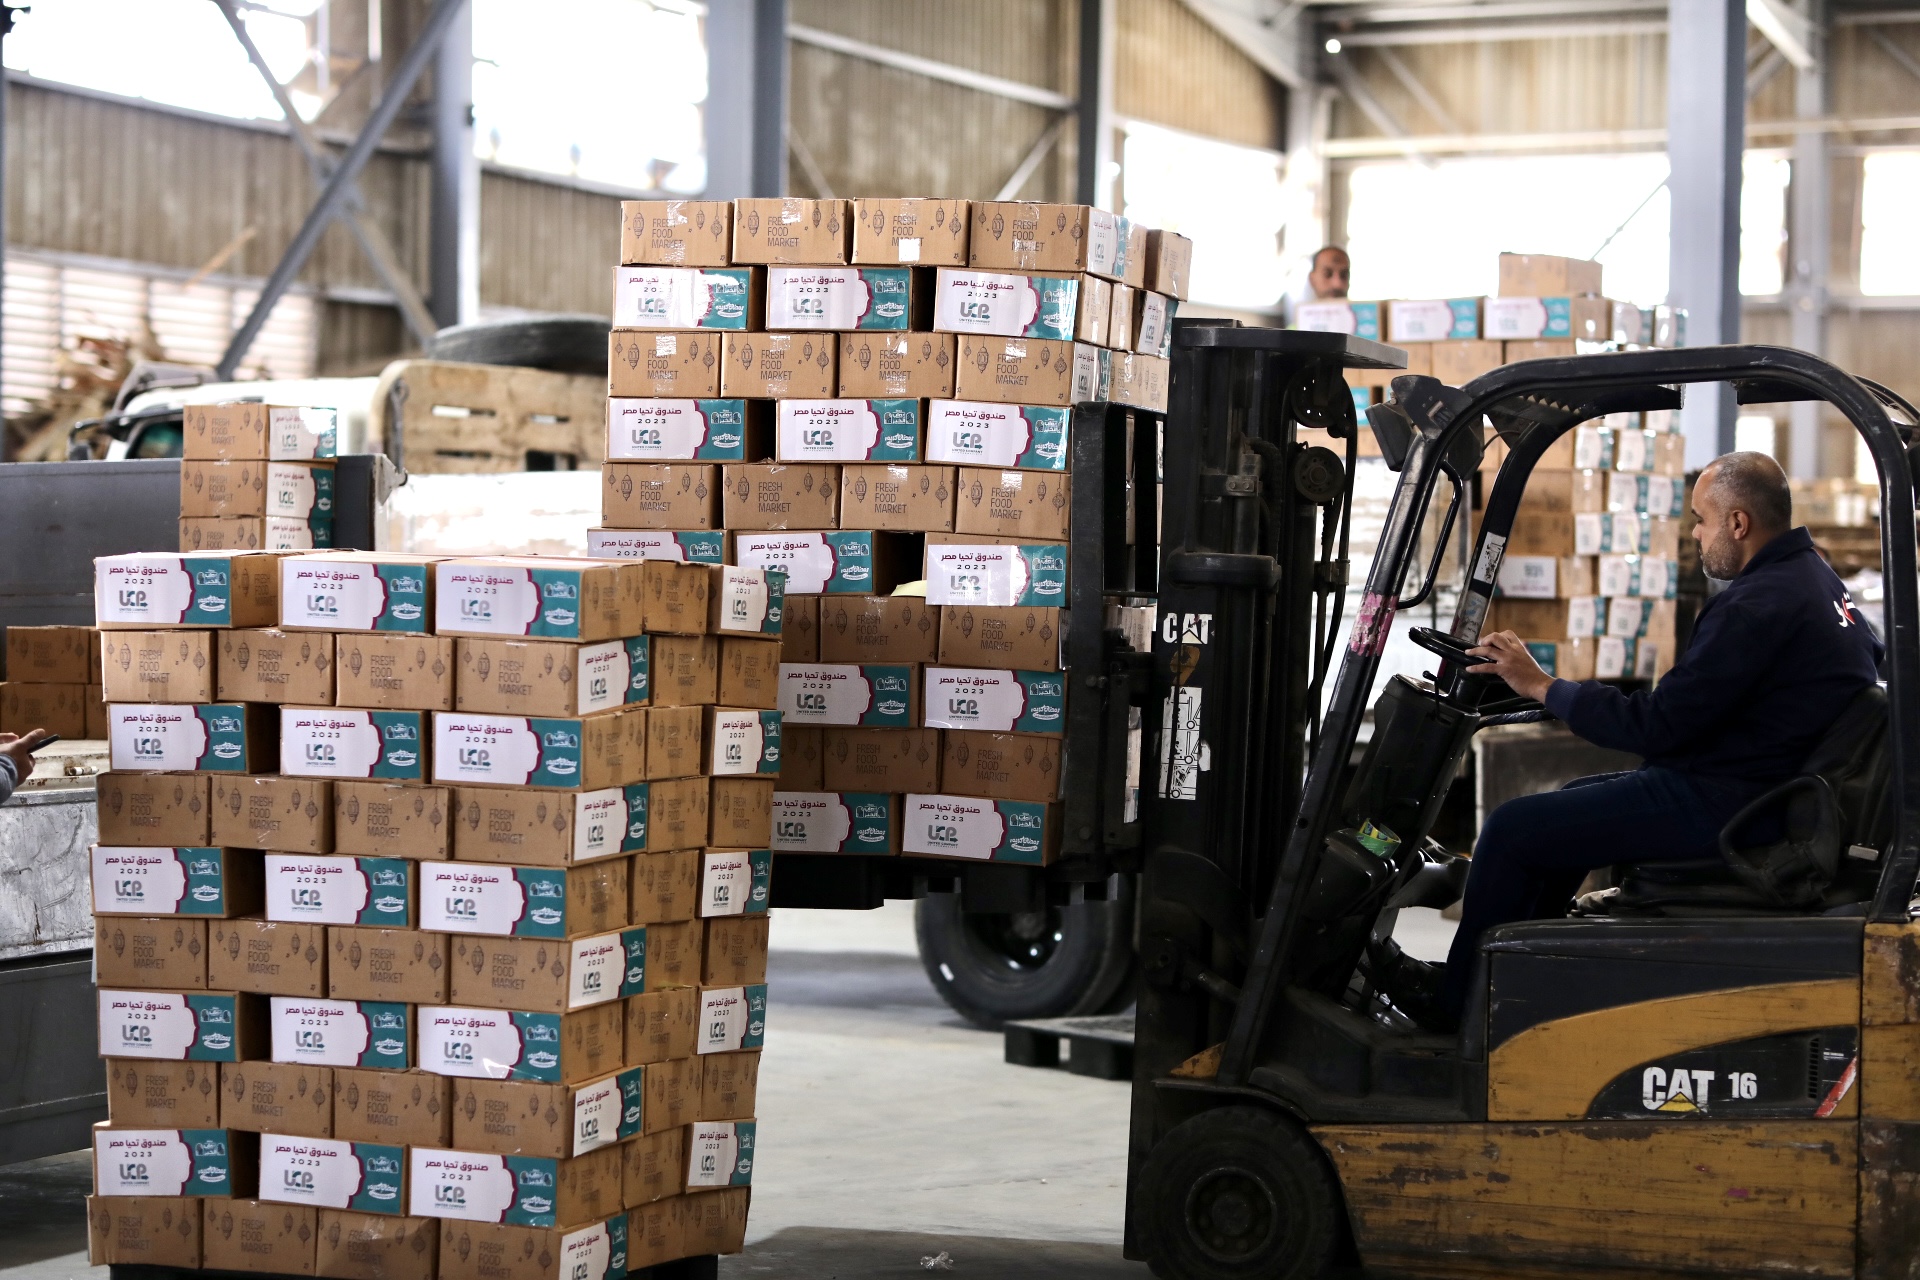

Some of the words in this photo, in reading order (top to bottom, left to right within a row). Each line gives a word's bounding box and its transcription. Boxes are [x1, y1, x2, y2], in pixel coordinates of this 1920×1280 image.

[768, 217, 792, 225] FRESH
[1013, 220, 1037, 229] FRESH
[767, 227, 788, 236] FOOD
[1012, 231, 1034, 240] FOOD
[767, 238, 799, 247] MARKET
[801, 276, 815, 284] تحيا
[818, 276, 844, 285] صندوق
[761, 350, 785, 359] FRESH
[761, 361, 782, 369] FOOD
[761, 371, 792, 380] MARKET
[655, 408, 681, 416] صندوق
[811, 408, 825, 416] تحيا
[827, 408, 854, 416] صندوق
[979, 412, 1005, 420] صندوق
[212, 436, 235, 444] MARKET
[641, 481, 663, 490] FRESH
[758, 482, 782, 491] FRESH
[875, 483, 899, 492] FRESH
[641, 492, 661, 500] FOOD
[758, 493, 779, 501] FOOD
[992, 488, 1015, 497] FRESH
[875, 494, 896, 502] FOOD
[991, 498, 1012, 507] FOOD
[640, 502, 671, 511] MARKET
[758, 503, 791, 512] MARKET
[875, 504, 907, 514] MARKET
[990, 509, 1022, 519] MARKET
[767, 542, 781, 550] تحيا
[783, 542, 809, 550] صندوق
[126, 566, 139, 575] تحيا
[141, 567, 167, 575] صندوق
[982, 619, 1007, 629] FRESH
[1162, 612, 1213, 645] CAT
[982, 630, 1003, 639] FOOD
[981, 640, 1014, 651] MARKET
[258, 650, 282, 659] FRESH
[371, 656, 395, 665] FRESH
[258, 662, 279, 671] FOOD
[500, 660, 523, 671] FRESH
[371, 667, 392, 677] FOOD
[805, 672, 819, 680] تحيا
[820, 672, 847, 681] صندوق
[258, 673, 290, 684] MARKET
[499, 672, 521, 683] FOOD
[957, 677, 971, 685] تحيا
[973, 677, 999, 686] صندوق
[371, 679, 403, 689] MARKET
[499, 684, 532, 695] MARKET
[140, 714, 153, 723] تحيا
[156, 714, 181, 723] صندوق
[313, 720, 327, 728] تحيا
[329, 720, 355, 729] صندوق
[468, 725, 482, 733] تحيا
[484, 725, 512, 734] صندوق
[978, 750, 1002, 760] FRESH
[977, 760, 998, 770] FOOD
[976, 771, 1010, 782] MARKET
[368, 803, 392, 813] FRESH
[937, 804, 951, 812] تحيا
[953, 805, 980, 814] صندوق
[490, 809, 514, 819] FRESH
[935, 814, 964, 822] 2023
[368, 815, 389, 825] FOOD
[489, 821, 511, 831] FOOD
[367, 827, 400, 837] MARKET
[489, 833, 523, 844] MARKET
[298, 865, 312, 874] تحيا
[315, 866, 342, 875] صندوق
[454, 874, 468, 882] تحيا
[471, 874, 499, 884] صندوق
[249, 940, 272, 950] FRESH
[248, 952, 270, 962] FOOD
[370, 948, 395, 959] FRESH
[493, 954, 517, 965] FRESH
[248, 963, 280, 975] MARKET
[370, 960, 392, 971] FOOD
[492, 966, 514, 976] FOOD
[370, 972, 403, 983] MARKET
[492, 978, 525, 990] MARKET
[253, 1081, 276, 1091] FRESH
[1642, 1066, 1715, 1113] CAT
[1728, 1072, 1757, 1099] 16
[253, 1093, 273, 1104] FOOD
[368, 1090, 390, 1102] FRESH
[252, 1105, 283, 1116] MARKET
[367, 1103, 388, 1113] FOOD
[367, 1114, 398, 1125] MARKET
[126, 1139, 139, 1148] تحيا
[141, 1139, 166, 1148] صندوق
[293, 1146, 307, 1155] تحيا
[309, 1148, 337, 1157] صندوق
[291, 1158, 320, 1166] 2023
